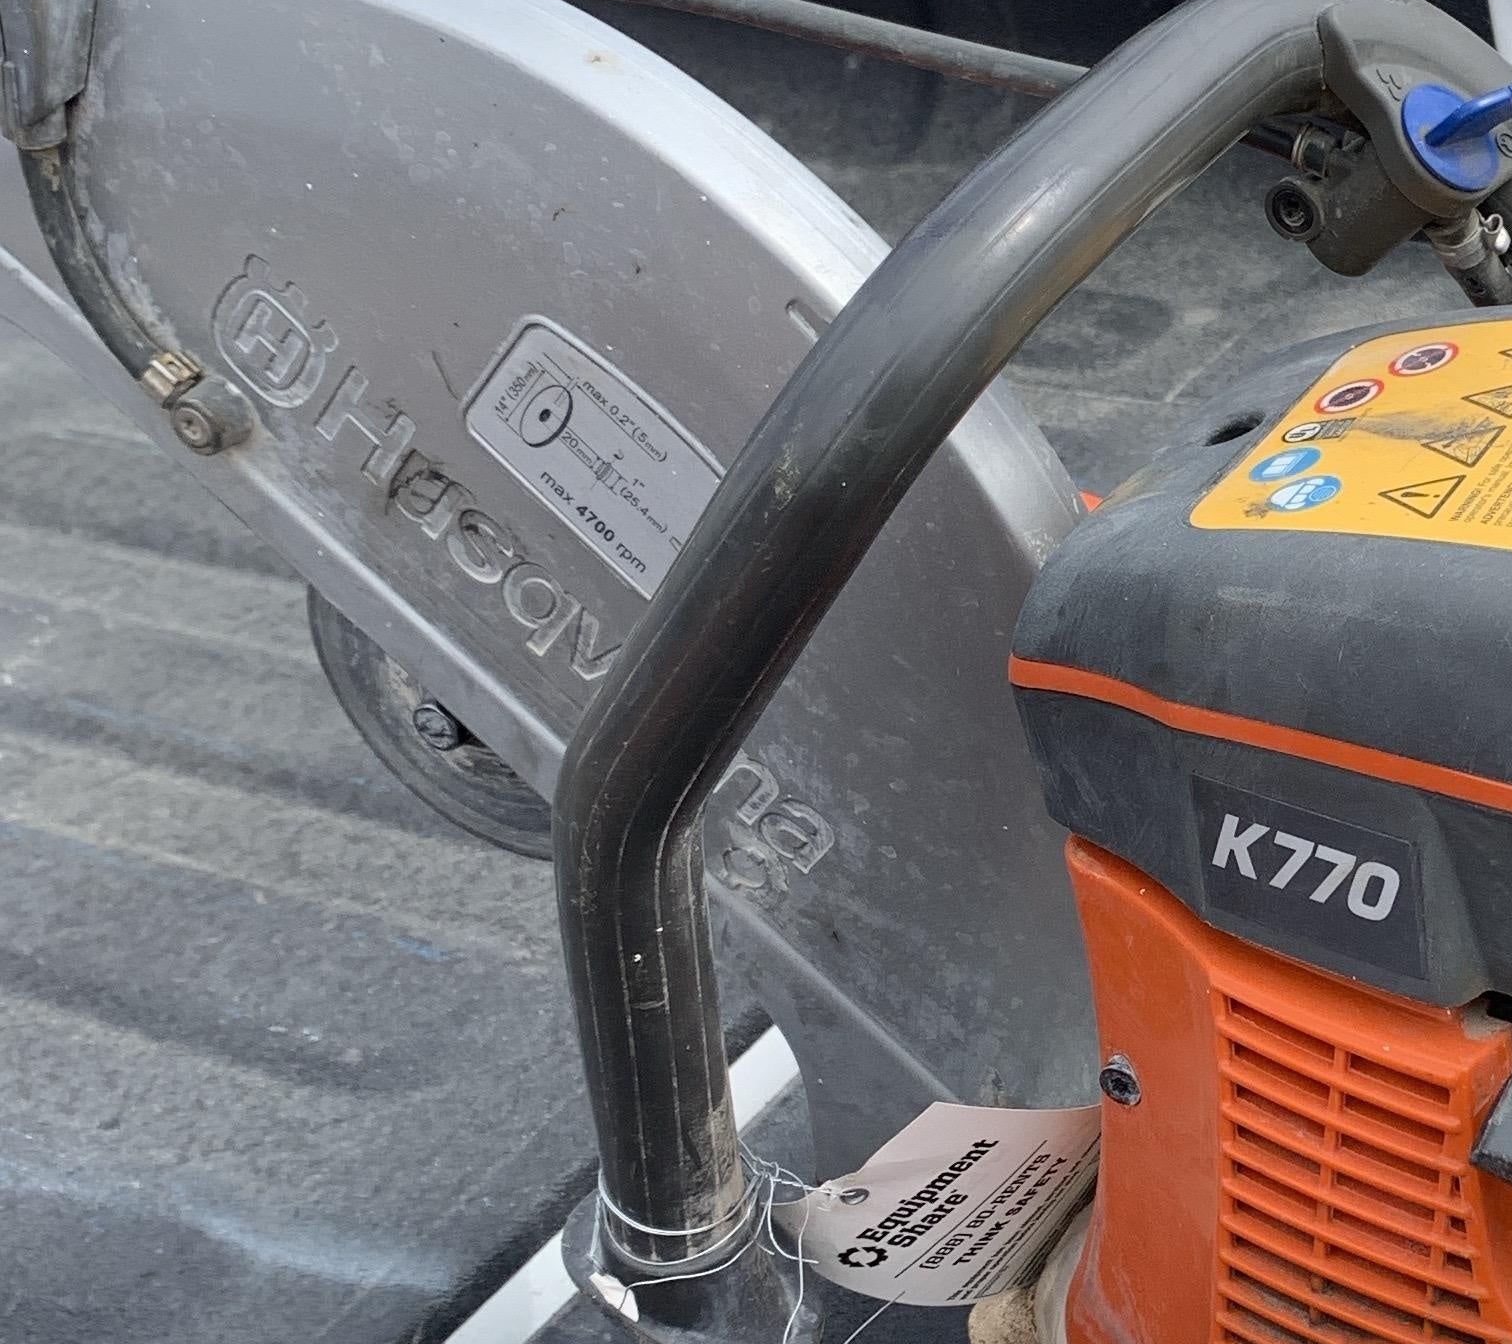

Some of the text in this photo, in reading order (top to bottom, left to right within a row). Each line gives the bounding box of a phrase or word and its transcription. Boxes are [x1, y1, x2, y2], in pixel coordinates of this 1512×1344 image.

[582, 379, 608, 408] max
[540, 471, 647, 573] max 4700 rpm
[856, 1137, 1000, 1243] Equipment
[953, 1220, 1011, 1266] THINK
[1004, 1156, 1069, 1217] SAFETY
[966, 1153, 1052, 1230] 80-RENTS
